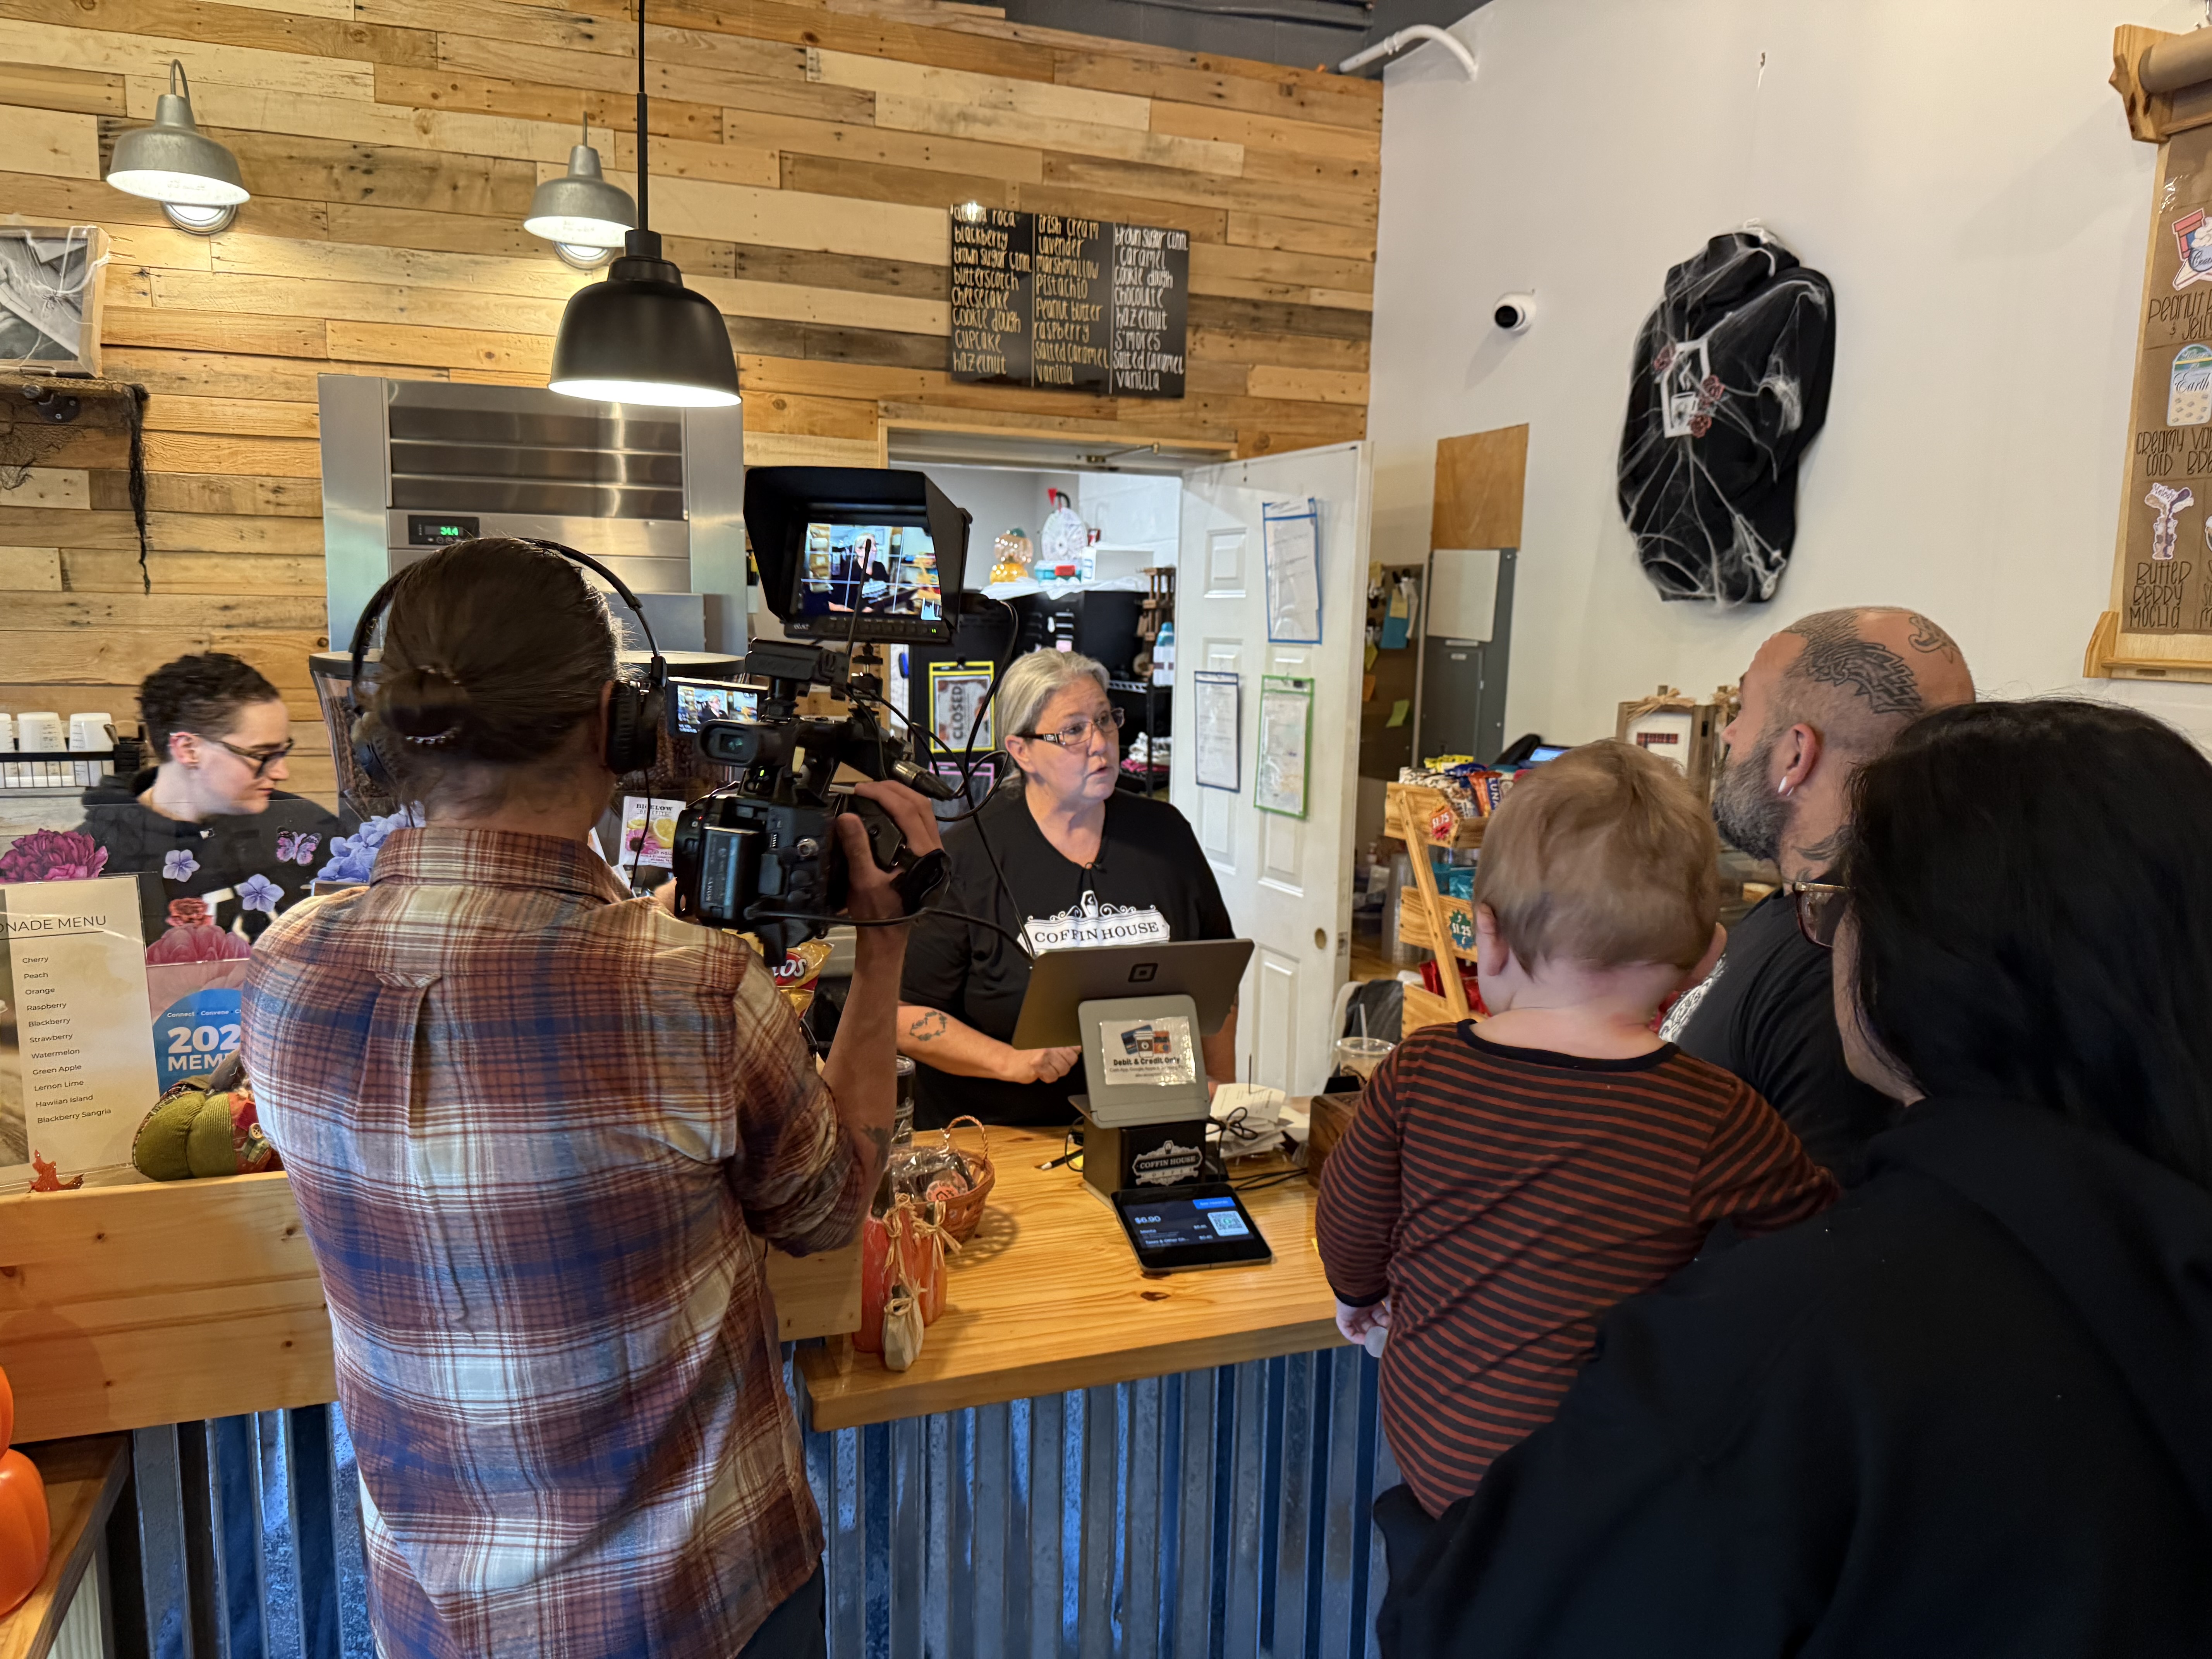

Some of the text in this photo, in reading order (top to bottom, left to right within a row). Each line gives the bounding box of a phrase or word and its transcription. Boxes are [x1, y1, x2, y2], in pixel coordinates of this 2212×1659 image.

[992, 210, 1016, 228] roca
[955, 225, 1008, 250] blackberry
[1038, 235, 1085, 258] lavender
[953, 246, 979, 265] brown
[980, 248, 1007, 268] sugar
[953, 266, 1019, 290] butterscotch
[1071, 300, 1103, 322] butter
[953, 350, 1007, 374] hazelnut
[951, 686, 964, 740] CLOSED
[58, 915, 106, 929] MENU
[27, 1003, 67, 1011] Raspberry
[29, 1018, 70, 1027] Blackberry
[30, 1034, 73, 1043] Strawberry
[168, 1024, 241, 1054] 202
[31, 1049, 80, 1058] Watermelon
[36, 1094, 93, 1107] Hawiian Island
[38, 1109, 111, 1123] Blackberry Sangria
[1140, 1156, 1196, 1169] COFFIN HOUSE
